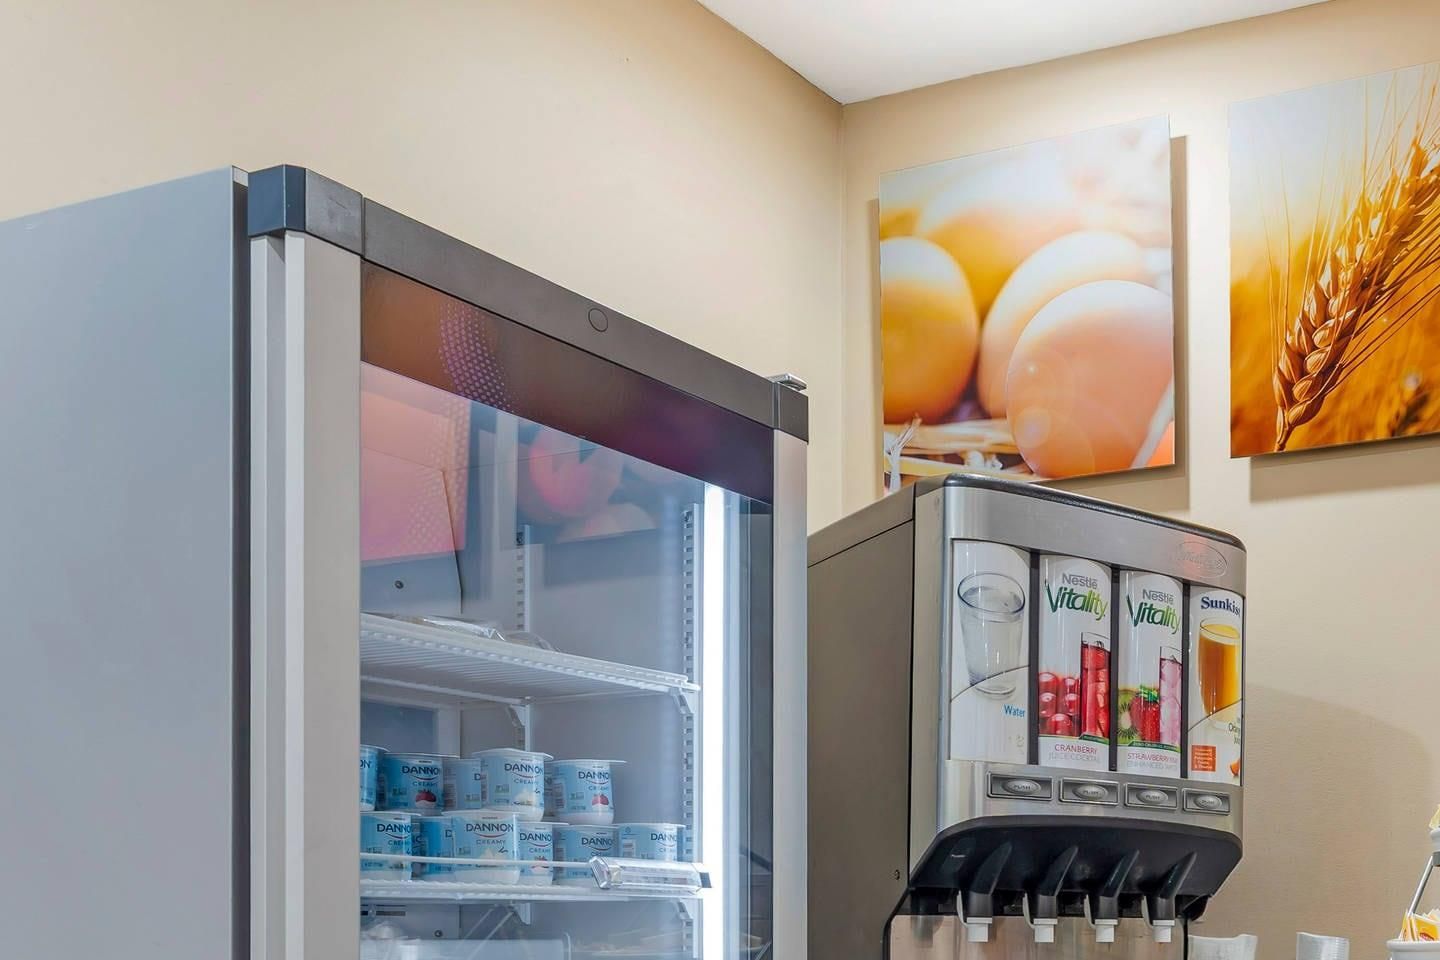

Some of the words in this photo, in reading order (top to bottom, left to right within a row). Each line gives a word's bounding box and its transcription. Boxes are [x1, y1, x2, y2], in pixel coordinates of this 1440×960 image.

[1045, 579, 1109, 621] Vitality
[1200, 596, 1241, 617] Sunkis
[1126, 594, 1180, 635] Vitality
[1004, 704, 1026, 718] Water
[1055, 744, 1098, 755] CRANBERRY
